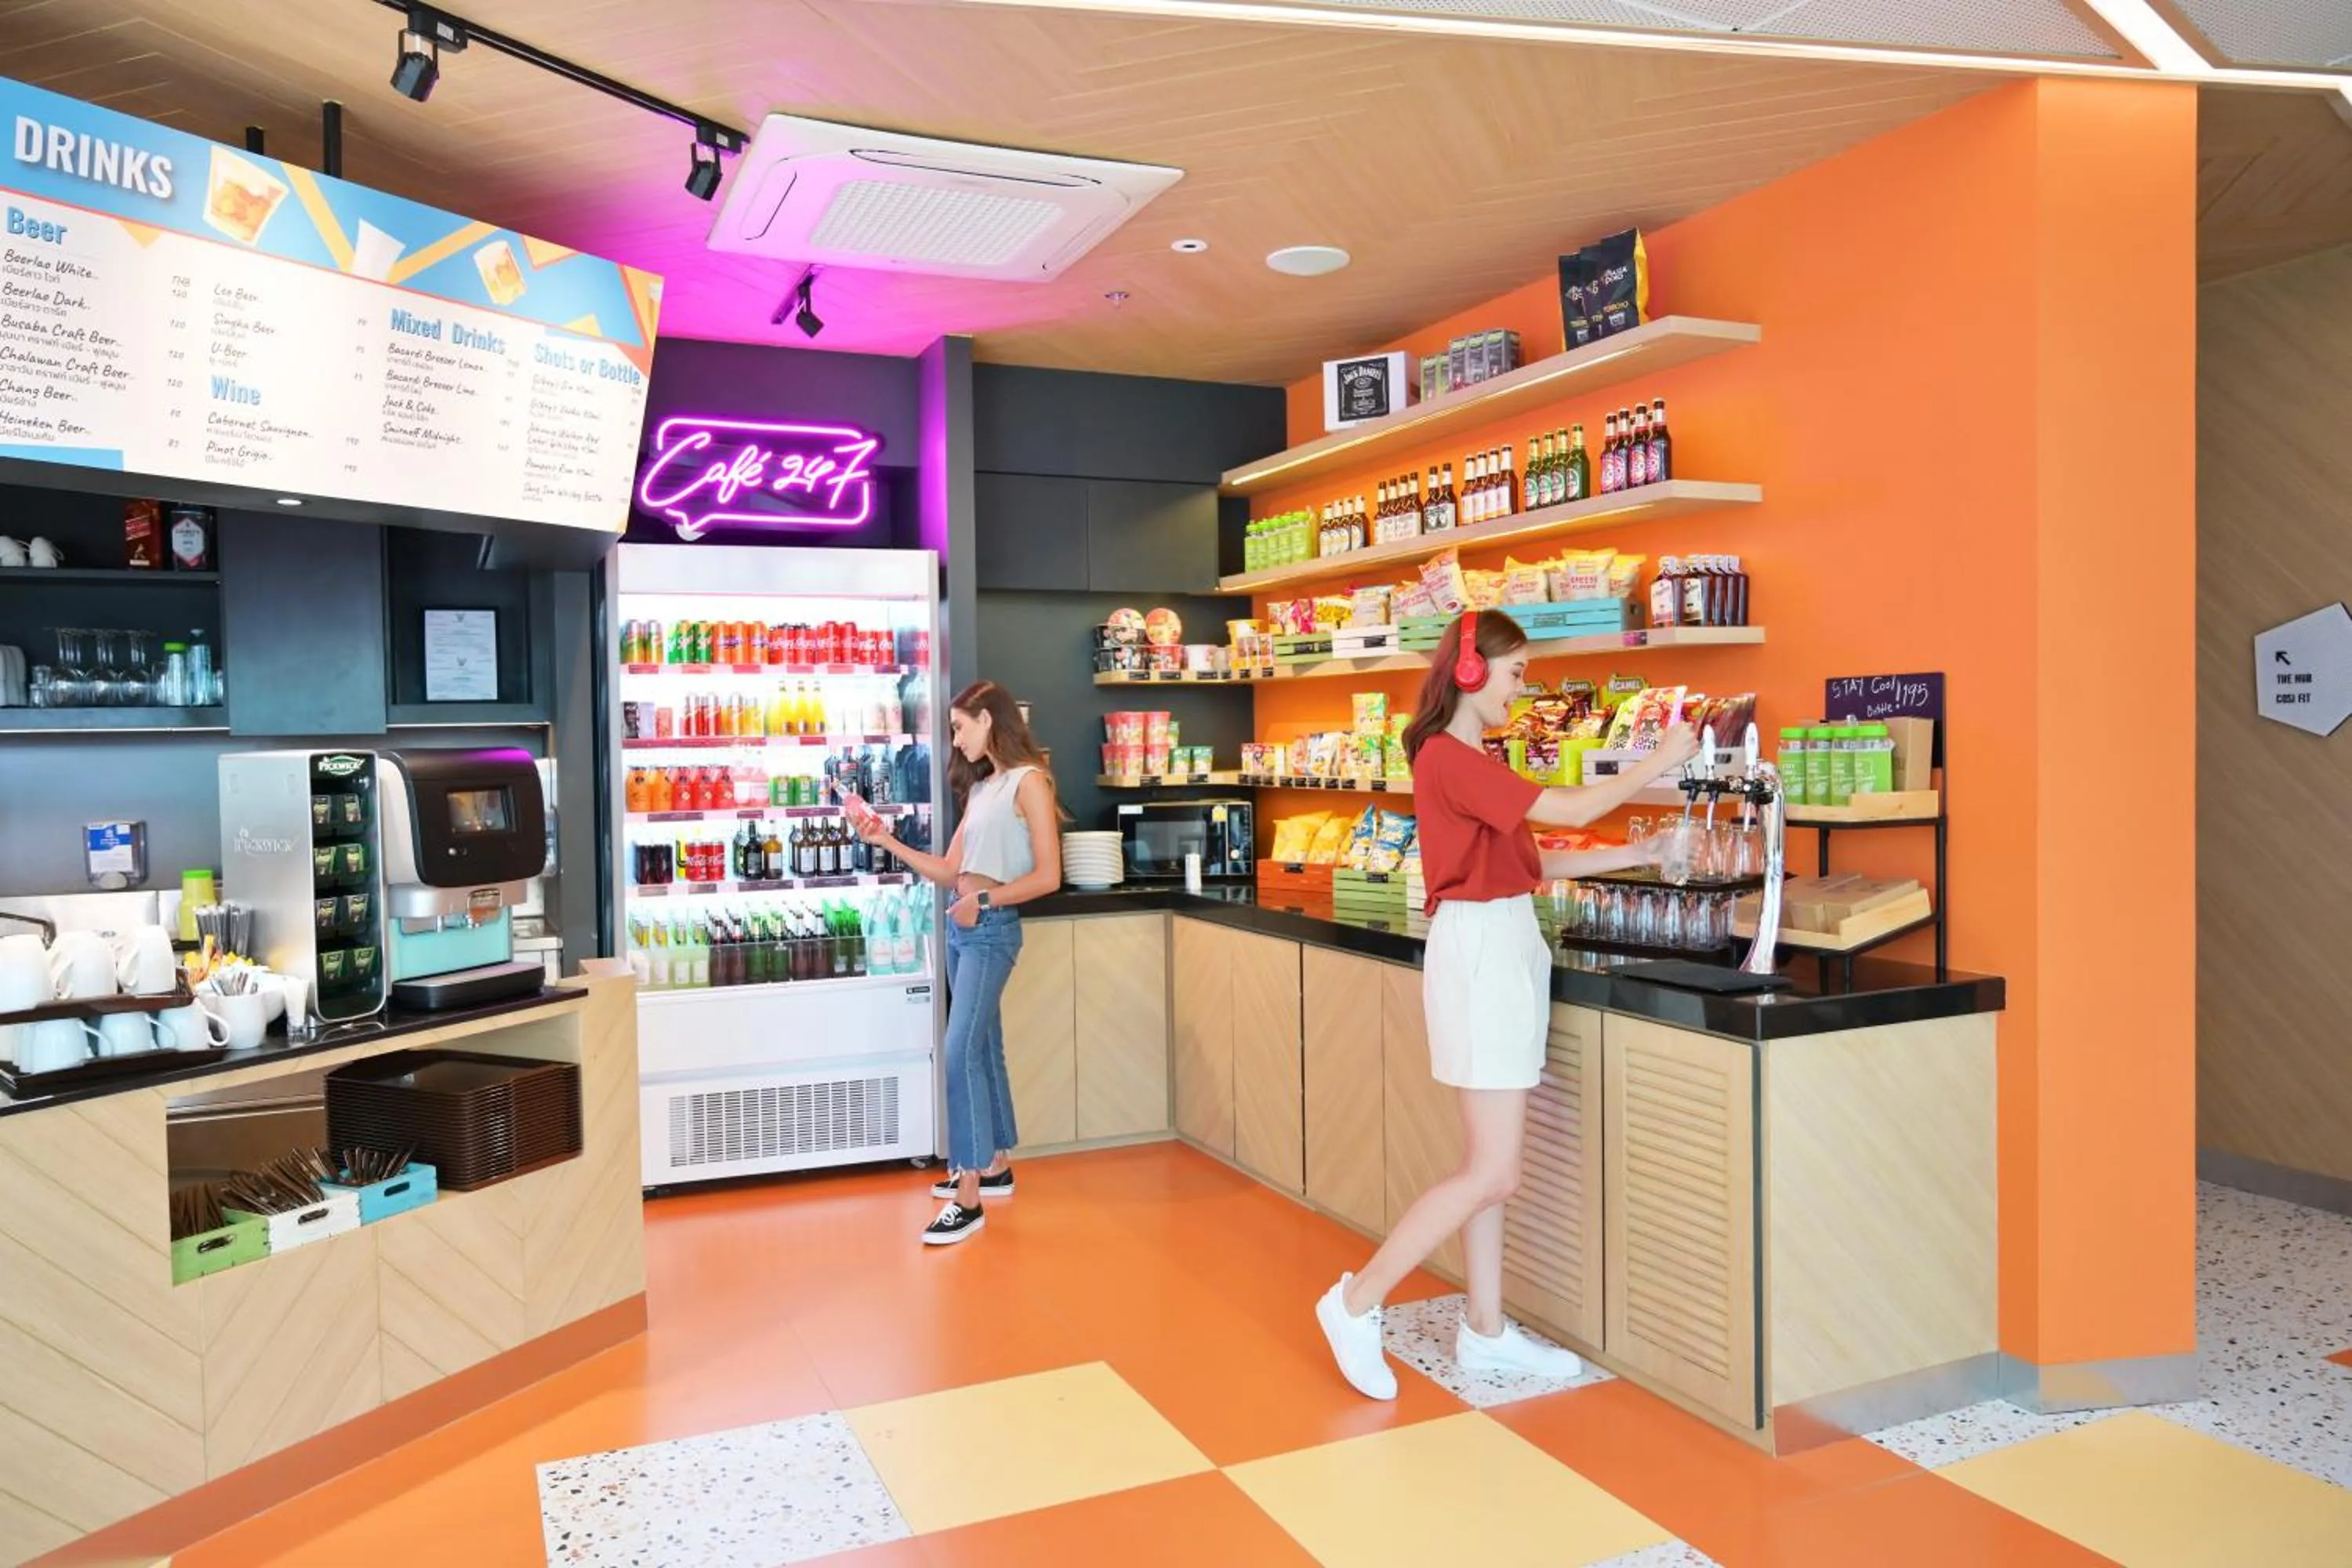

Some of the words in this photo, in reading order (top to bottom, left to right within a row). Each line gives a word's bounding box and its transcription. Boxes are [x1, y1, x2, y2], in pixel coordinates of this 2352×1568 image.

[14, 114, 174, 199] DRINKS
[7, 206, 68, 245] Beer
[4, 249, 51, 270] Beerlao
[2, 281, 50, 302] Beerlao
[53, 324, 85, 341] Craft
[390, 308, 441, 340] Mixed
[452, 322, 507, 355] Drinks
[65, 358, 99, 376] Craft
[535, 343, 575, 371] Shots
[580, 358, 594, 375] or
[600, 359, 641, 386] Bottle
[0, 379, 39, 398] Chang
[211, 374, 261, 406] Wine
[383, 394, 404, 409] Jack
[0, 409, 53, 430] Heineken
[209, 412, 256, 430] Cabernet
[206, 440, 235, 455] Pinot
[640, 431, 772, 508] Café
[1614, 680, 1641, 690] CAMEL
[1831, 677, 1864, 699] STAY
[2277, 673, 2291, 684] THE
[2295, 673, 2312, 684] HUB
[2276, 694, 2295, 703] COSI
[2298, 693, 2311, 703] FIT
